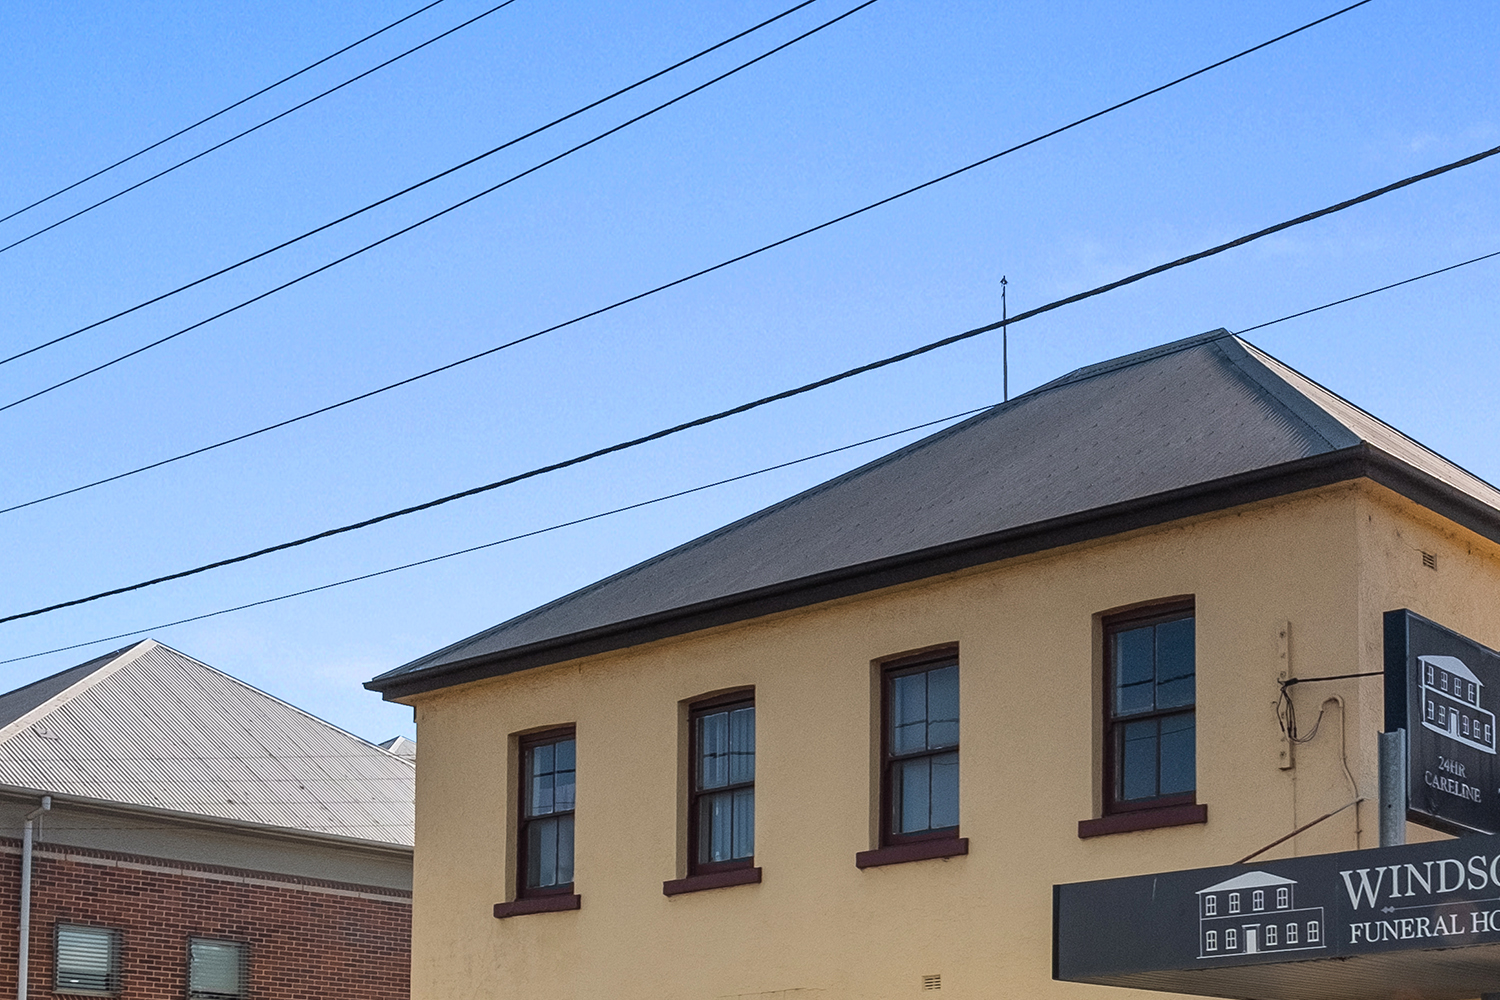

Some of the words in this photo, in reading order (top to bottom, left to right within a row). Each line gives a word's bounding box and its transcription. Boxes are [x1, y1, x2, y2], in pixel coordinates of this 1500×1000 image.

[1438, 756, 1467, 779] 24HR
[1425, 770, 1482, 803] CARELINE
[1349, 913, 1466, 945] FUNERAL
